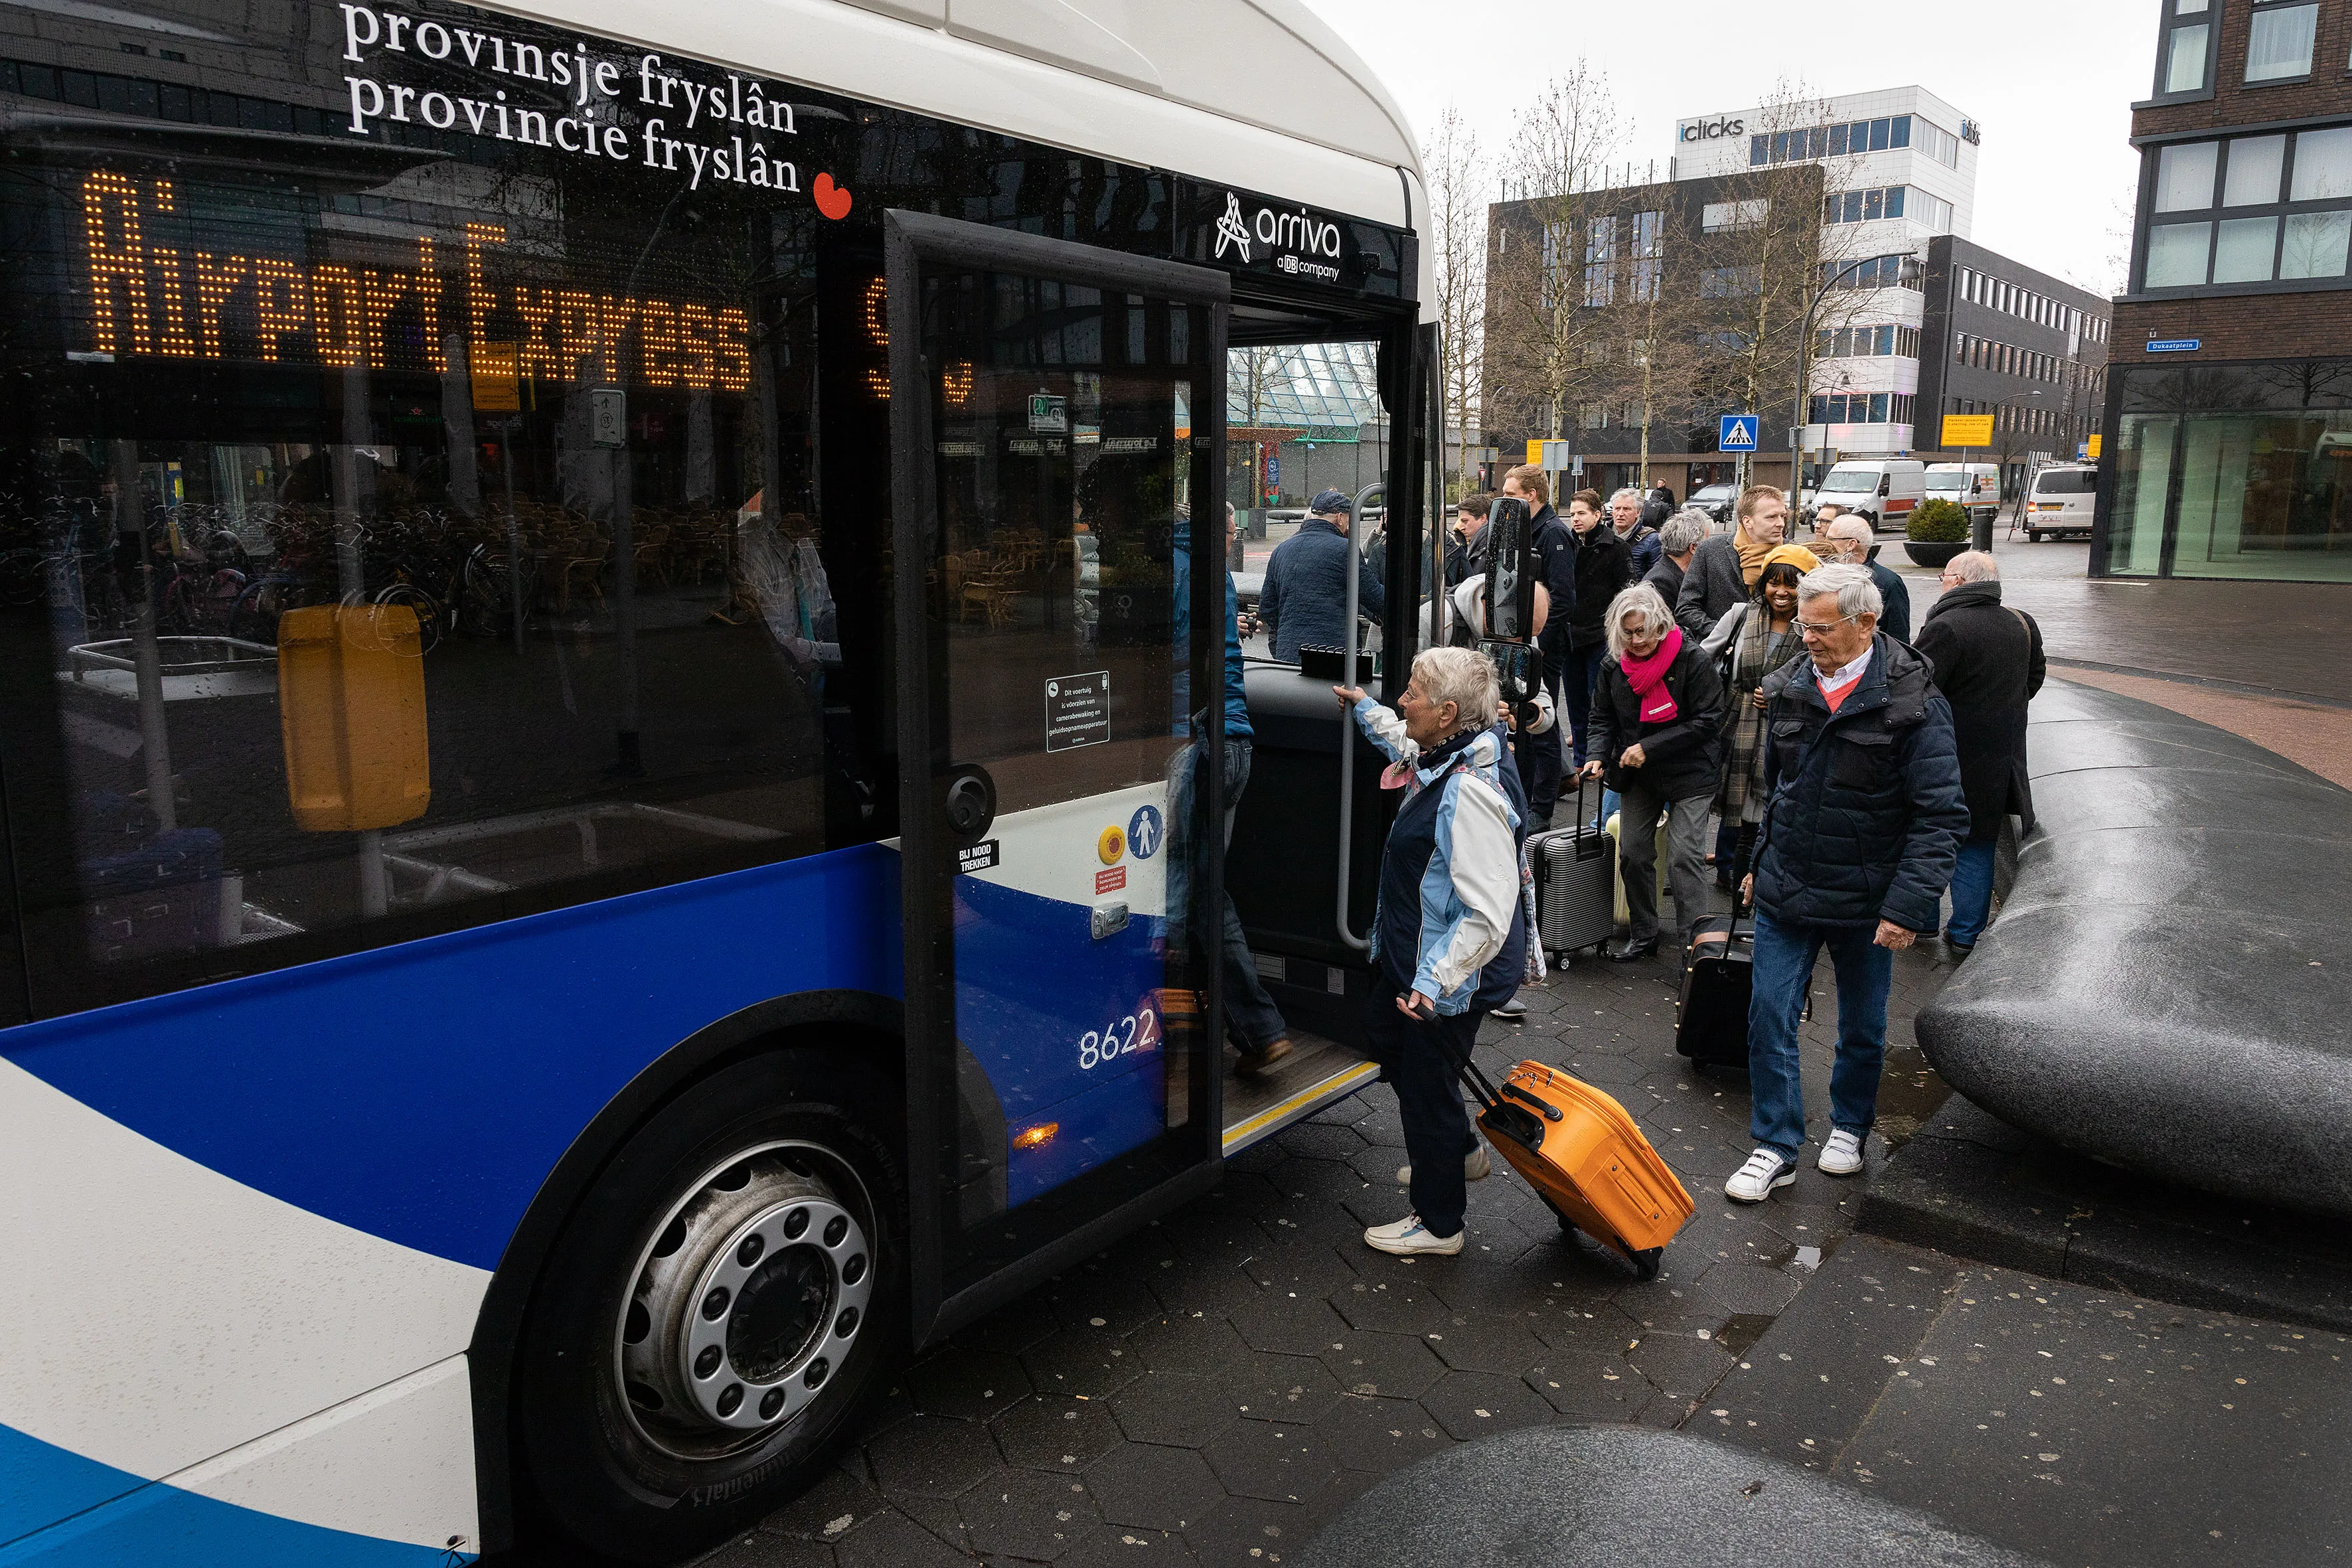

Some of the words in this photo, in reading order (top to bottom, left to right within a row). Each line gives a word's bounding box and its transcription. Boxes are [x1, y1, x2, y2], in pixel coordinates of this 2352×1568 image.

[339, 3, 620, 106] provinsje
[638, 54, 797, 134] fryslân
[344, 76, 629, 160] provincie
[642, 119, 800, 193] fryslân
[1680, 116, 1743, 142] iclicks
[1256, 207, 1340, 259] arriva
[84, 172, 447, 373] Airport
[467, 222, 750, 391] Express
[1277, 257, 1283, 268] a
[1285, 257, 1296, 271] DB
[1298, 261, 1340, 281] company
[1073, 686, 1092, 695] voertuig
[1049, 720, 1107, 737] geluidsopnameapparatuur
[1056, 710, 1094, 722] camerabewaking
[959, 848, 971, 860] BIJ
[972, 844, 991, 857] NOOD
[960, 856, 990, 872] TREKKEN
[1080, 1008, 1154, 1069] 8622
